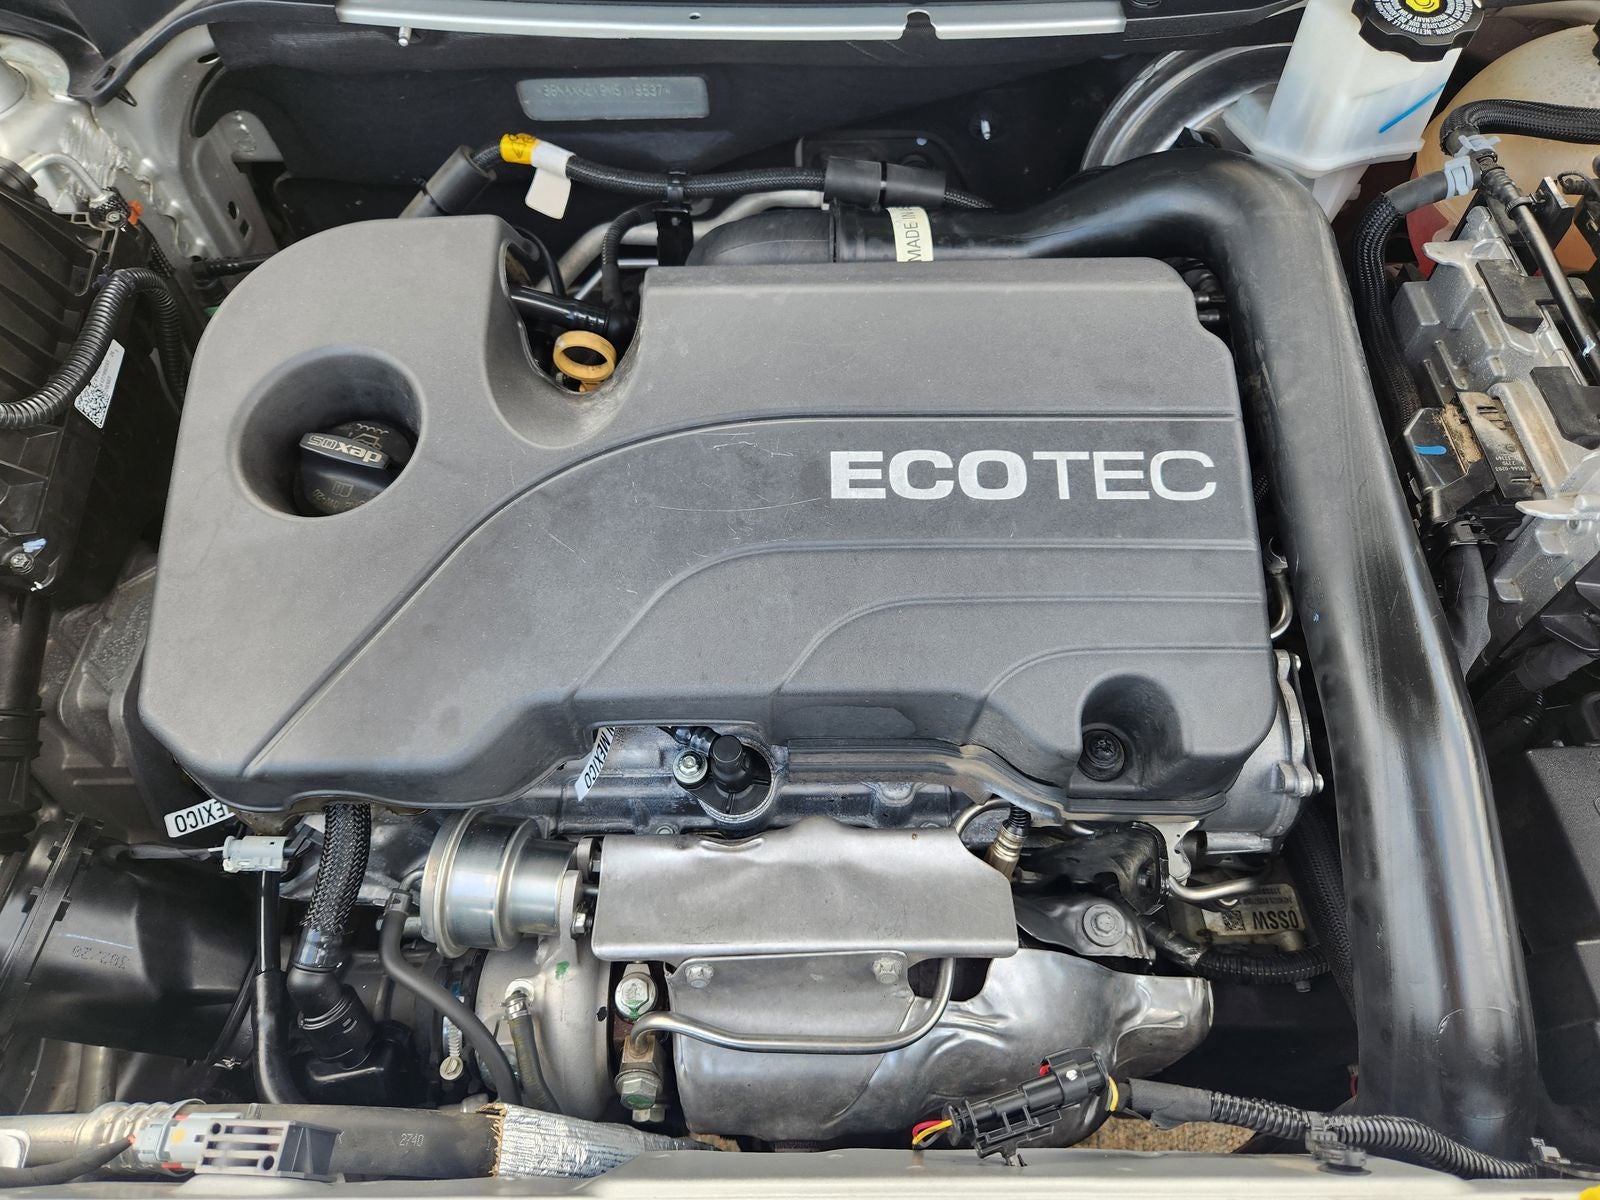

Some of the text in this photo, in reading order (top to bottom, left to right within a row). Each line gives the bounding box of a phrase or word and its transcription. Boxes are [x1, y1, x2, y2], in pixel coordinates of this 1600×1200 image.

[903, 222, 921, 262] MADE
[307, 435, 383, 463] dexos
[830, 450, 1217, 501] ECOTEC
[584, 731, 611, 789] MEXICO
[174, 801, 226, 833] EXICO
[399, 1132, 425, 1147] 2740
